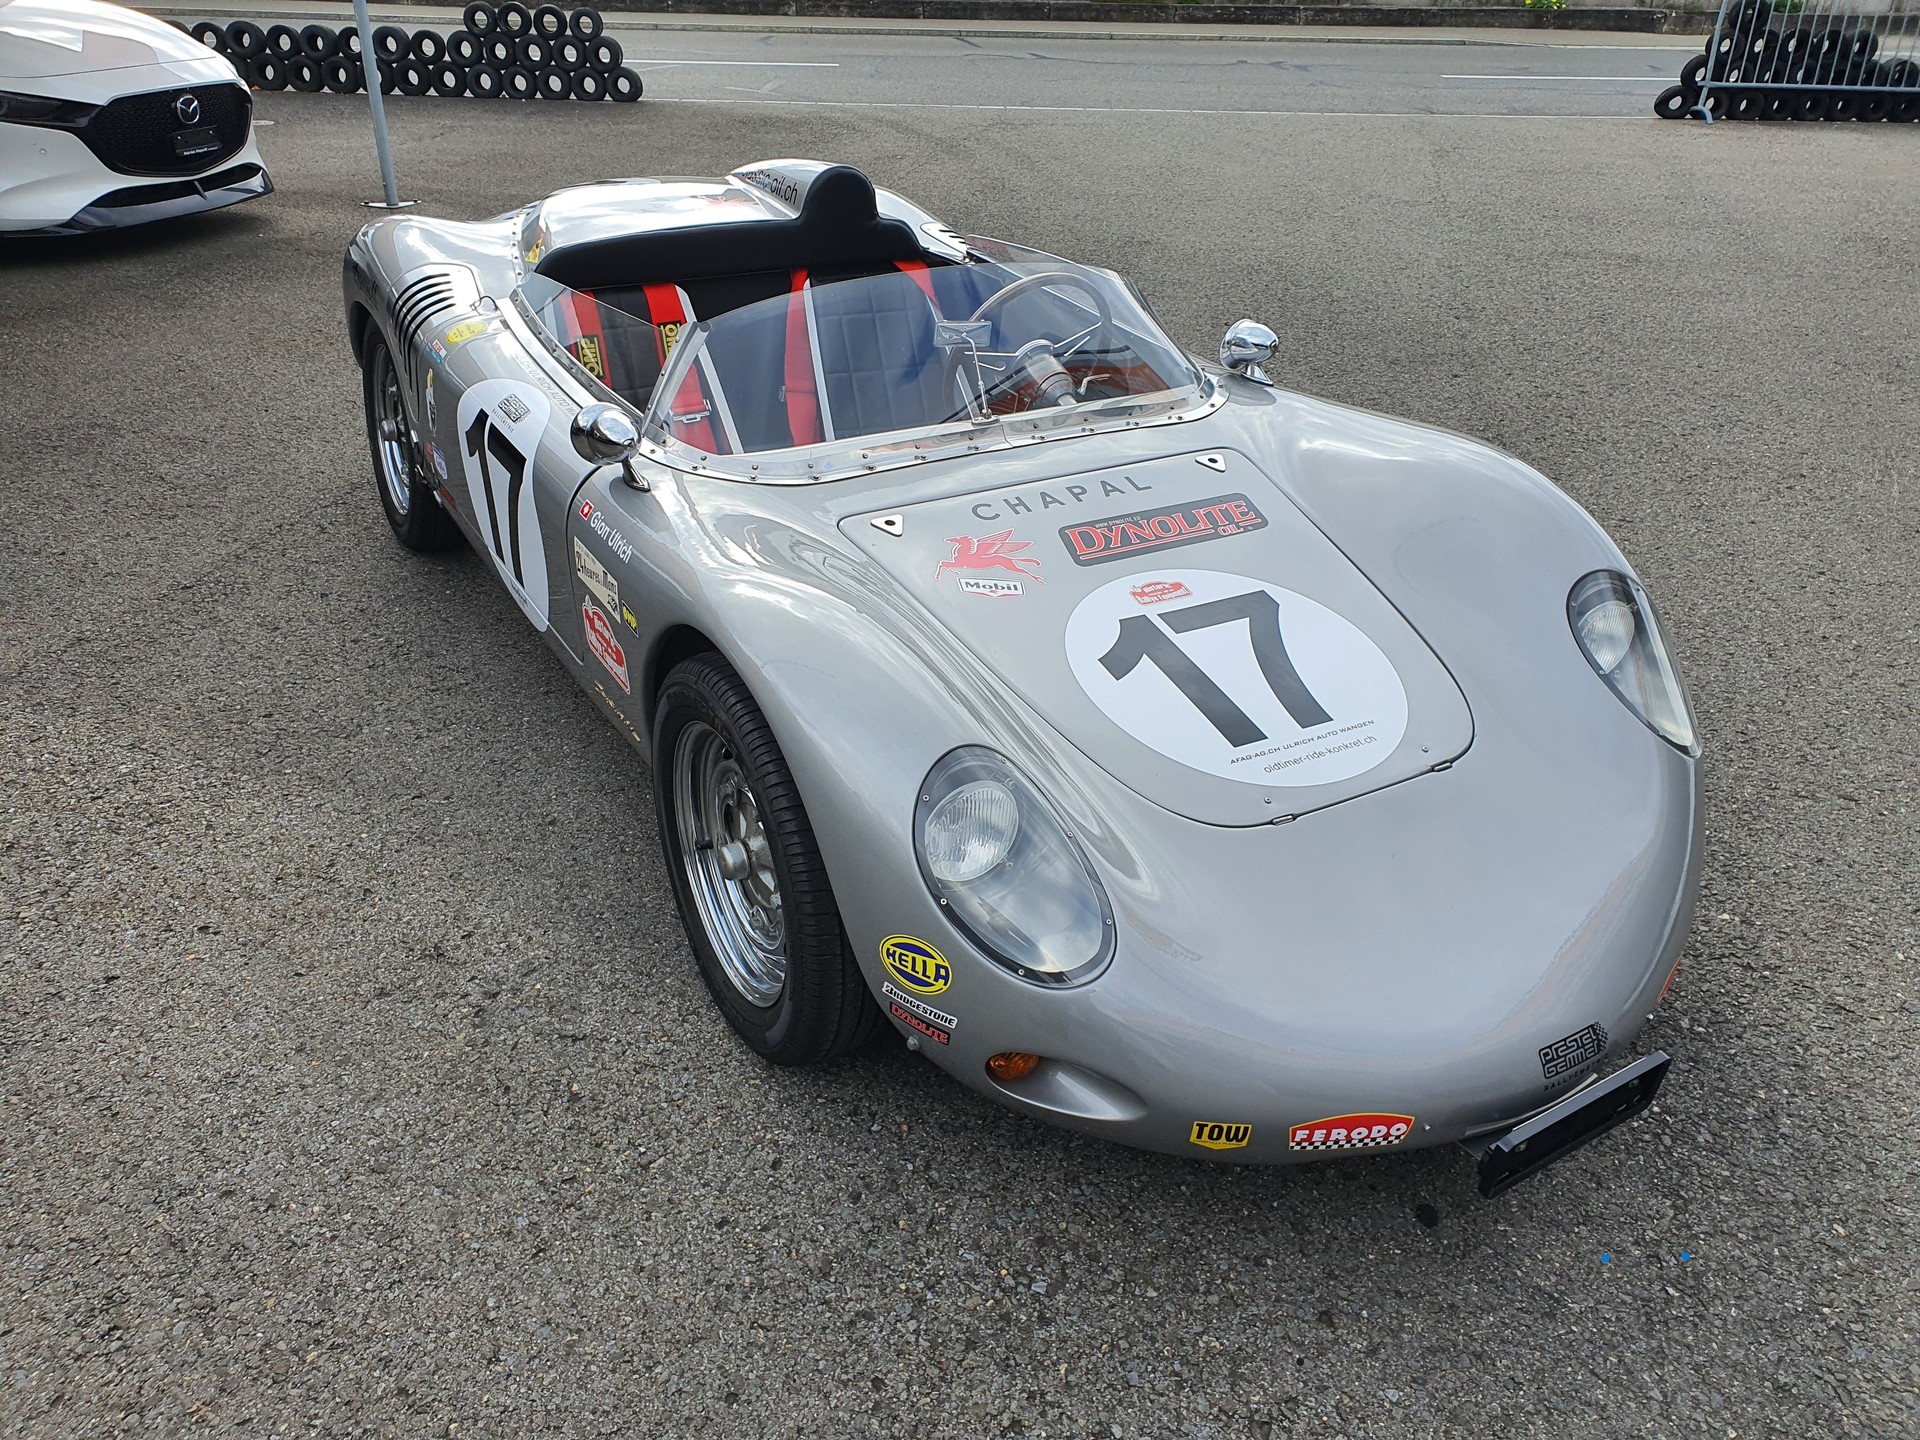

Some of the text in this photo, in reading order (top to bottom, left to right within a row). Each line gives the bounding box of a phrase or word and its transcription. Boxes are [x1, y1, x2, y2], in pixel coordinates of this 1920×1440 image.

[465, 407, 527, 590] 17
[971, 476, 1153, 521] CHAPAL
[590, 511, 633, 564] Gion Ulrich
[1065, 500, 1256, 555] DYNOLITE
[1217, 524, 1244, 537] OIL
[964, 581, 1019, 592] Mobil
[1097, 589, 1335, 749] 17
[1263, 735, 1378, 774] oldtimer-ride-konkret.ch
[1283, 737, 1315, 750] ULRICH
[1316, 730, 1338, 741] AUTO
[1339, 719, 1375, 733] WANGEN
[886, 947, 950, 987] HELLA
[885, 984, 956, 1027] BRIDGESTONE
[1195, 1123, 1250, 1142] TOW
[1294, 1122, 1408, 1142] FERODO
